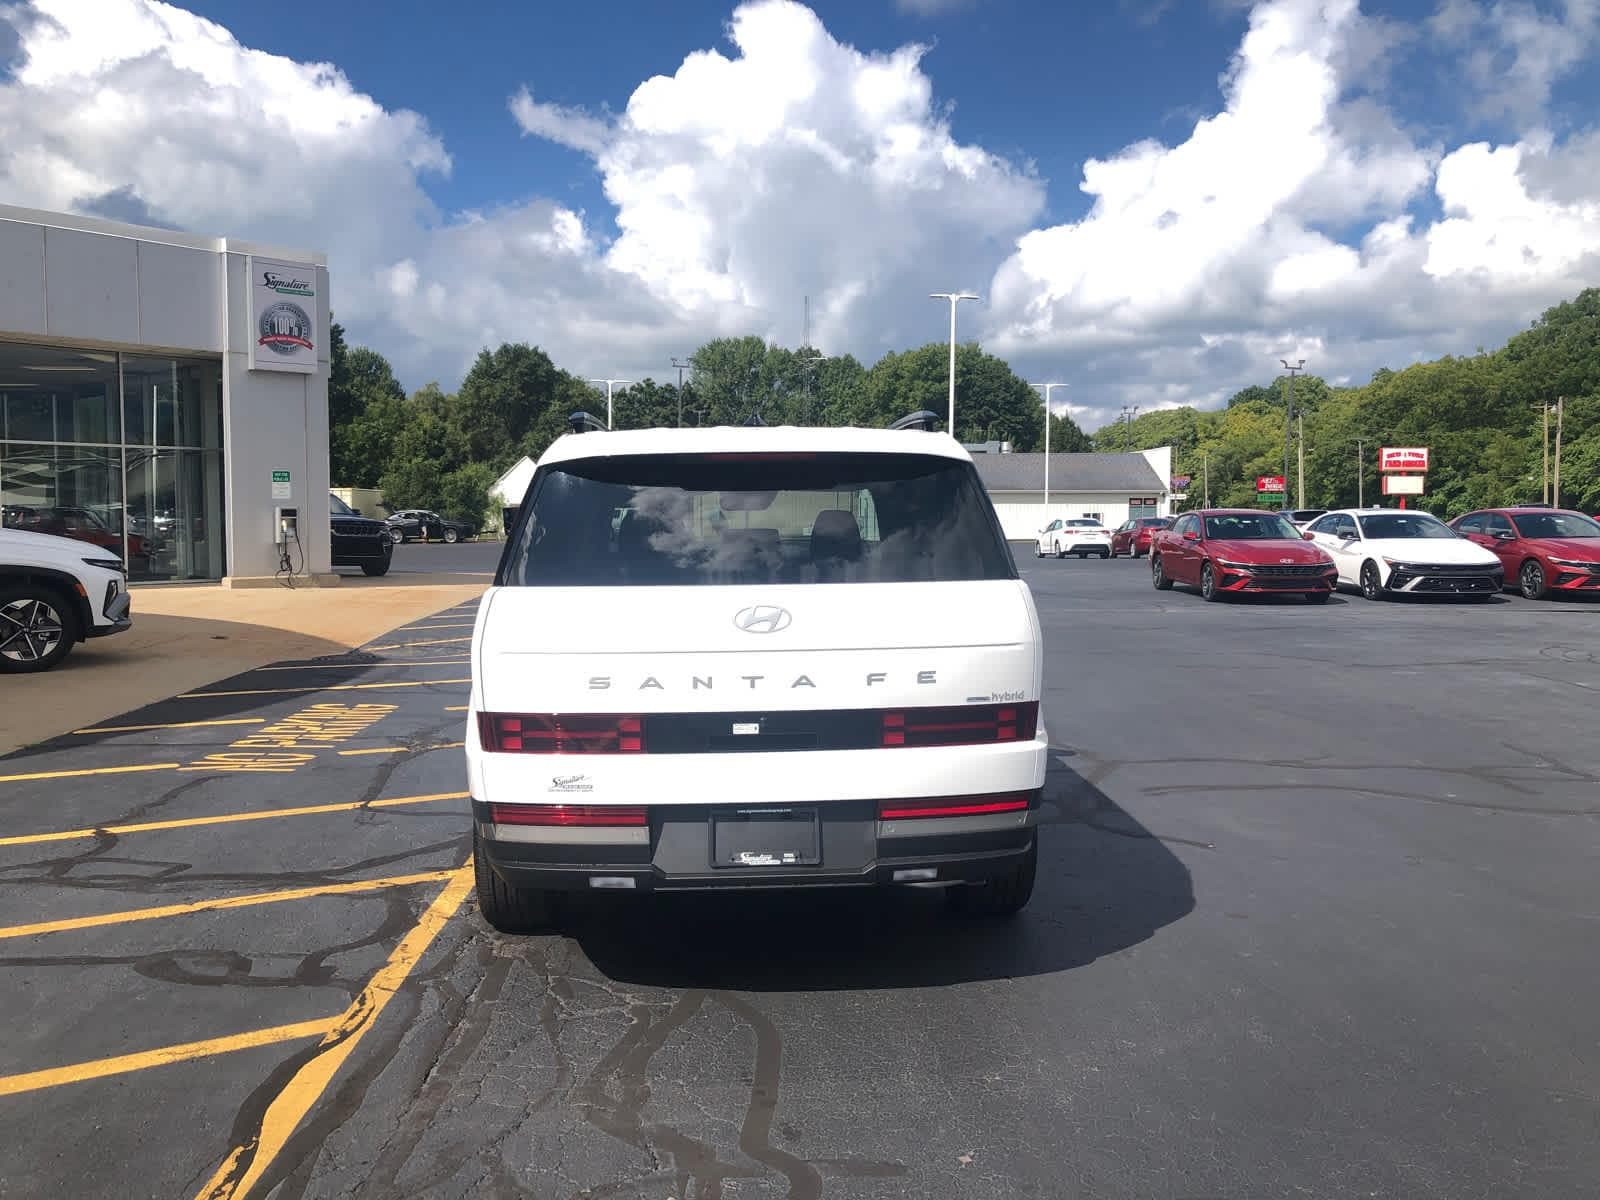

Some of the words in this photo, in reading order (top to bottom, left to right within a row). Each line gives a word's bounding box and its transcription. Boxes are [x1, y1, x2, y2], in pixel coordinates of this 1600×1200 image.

[263, 271, 310, 290] Signature
[273, 317, 299, 337] 100%
[588, 674, 817, 690] SANTA
[866, 670, 937, 687] FE
[991, 690, 1025, 703] hybrid
[227, 703, 400, 749] PARKING
[176, 752, 318, 772] NO
